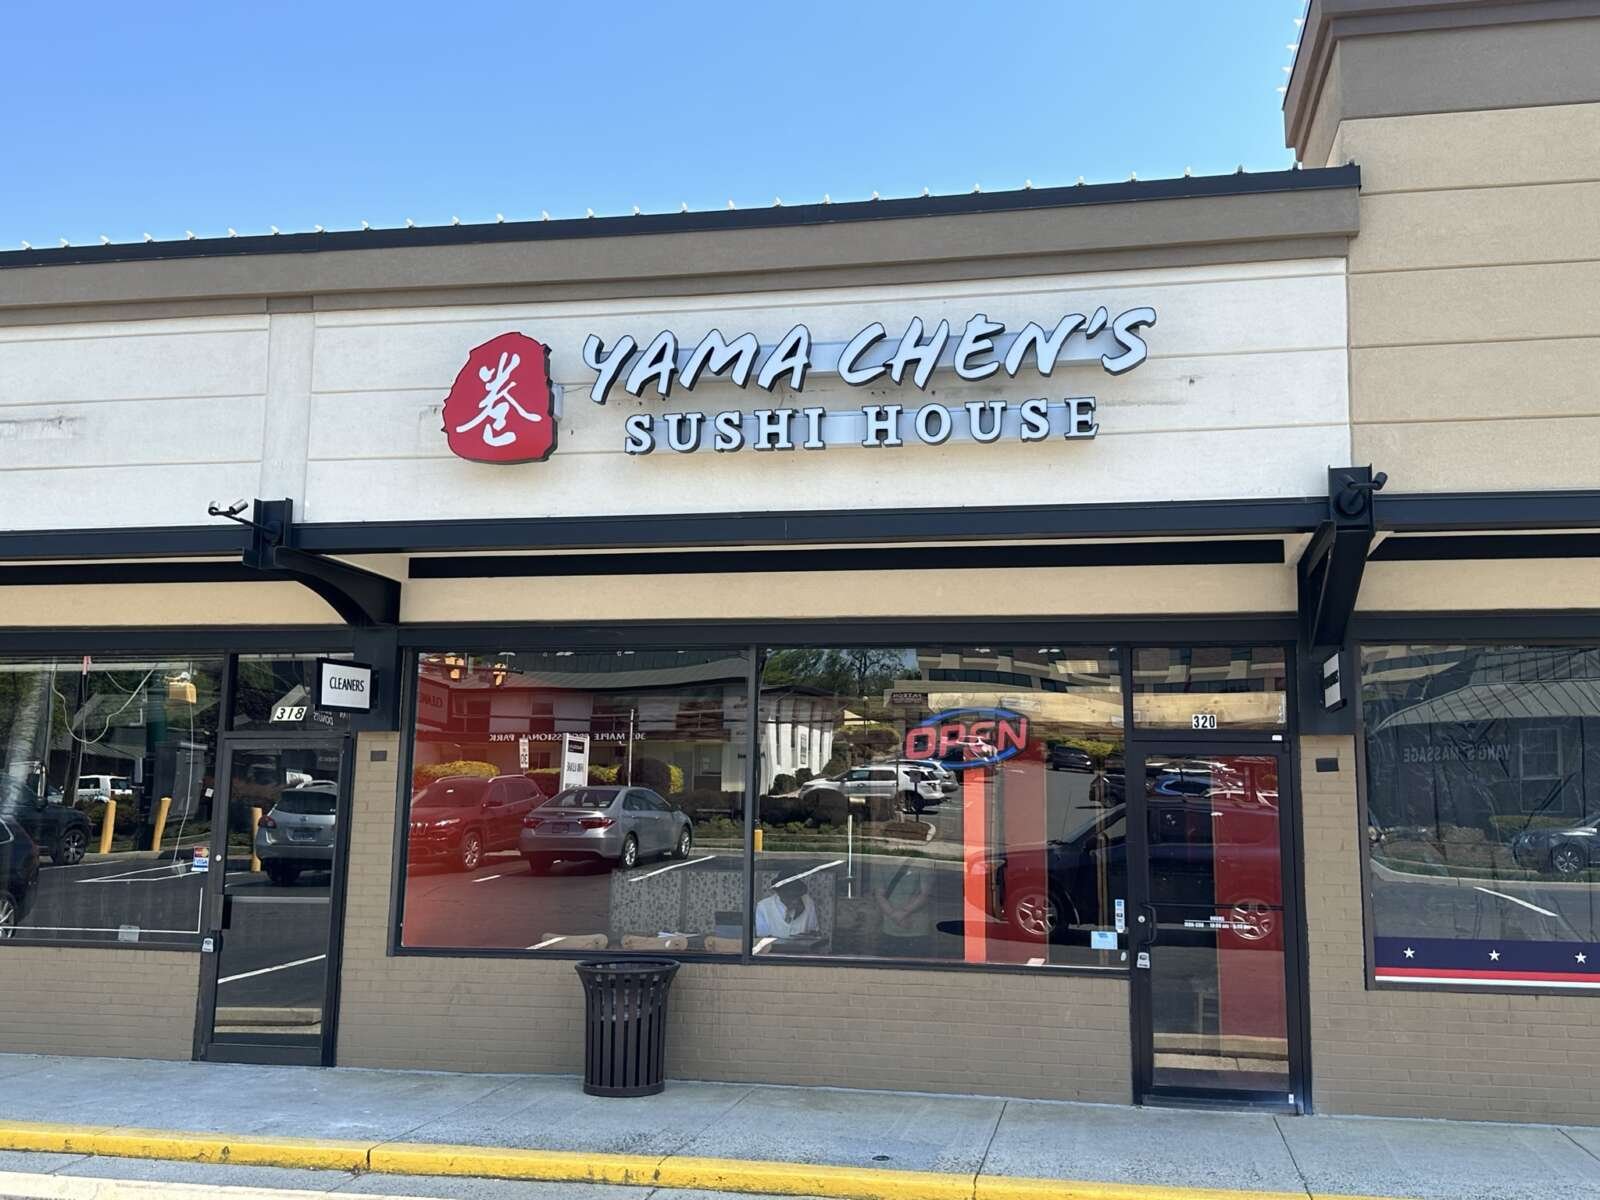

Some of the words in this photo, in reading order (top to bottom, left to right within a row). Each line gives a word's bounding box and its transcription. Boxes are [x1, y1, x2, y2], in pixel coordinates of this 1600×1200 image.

[582, 323, 812, 405] YAMA
[837, 305, 1157, 391] CHEN'S
[624, 406, 826, 456] SUSHI
[861, 396, 1099, 447] HOUSE
[329, 676, 365, 693] CLEANERS
[276, 707, 305, 720] 318
[1193, 714, 1216, 729] 320
[905, 717, 1027, 761] OPEN
